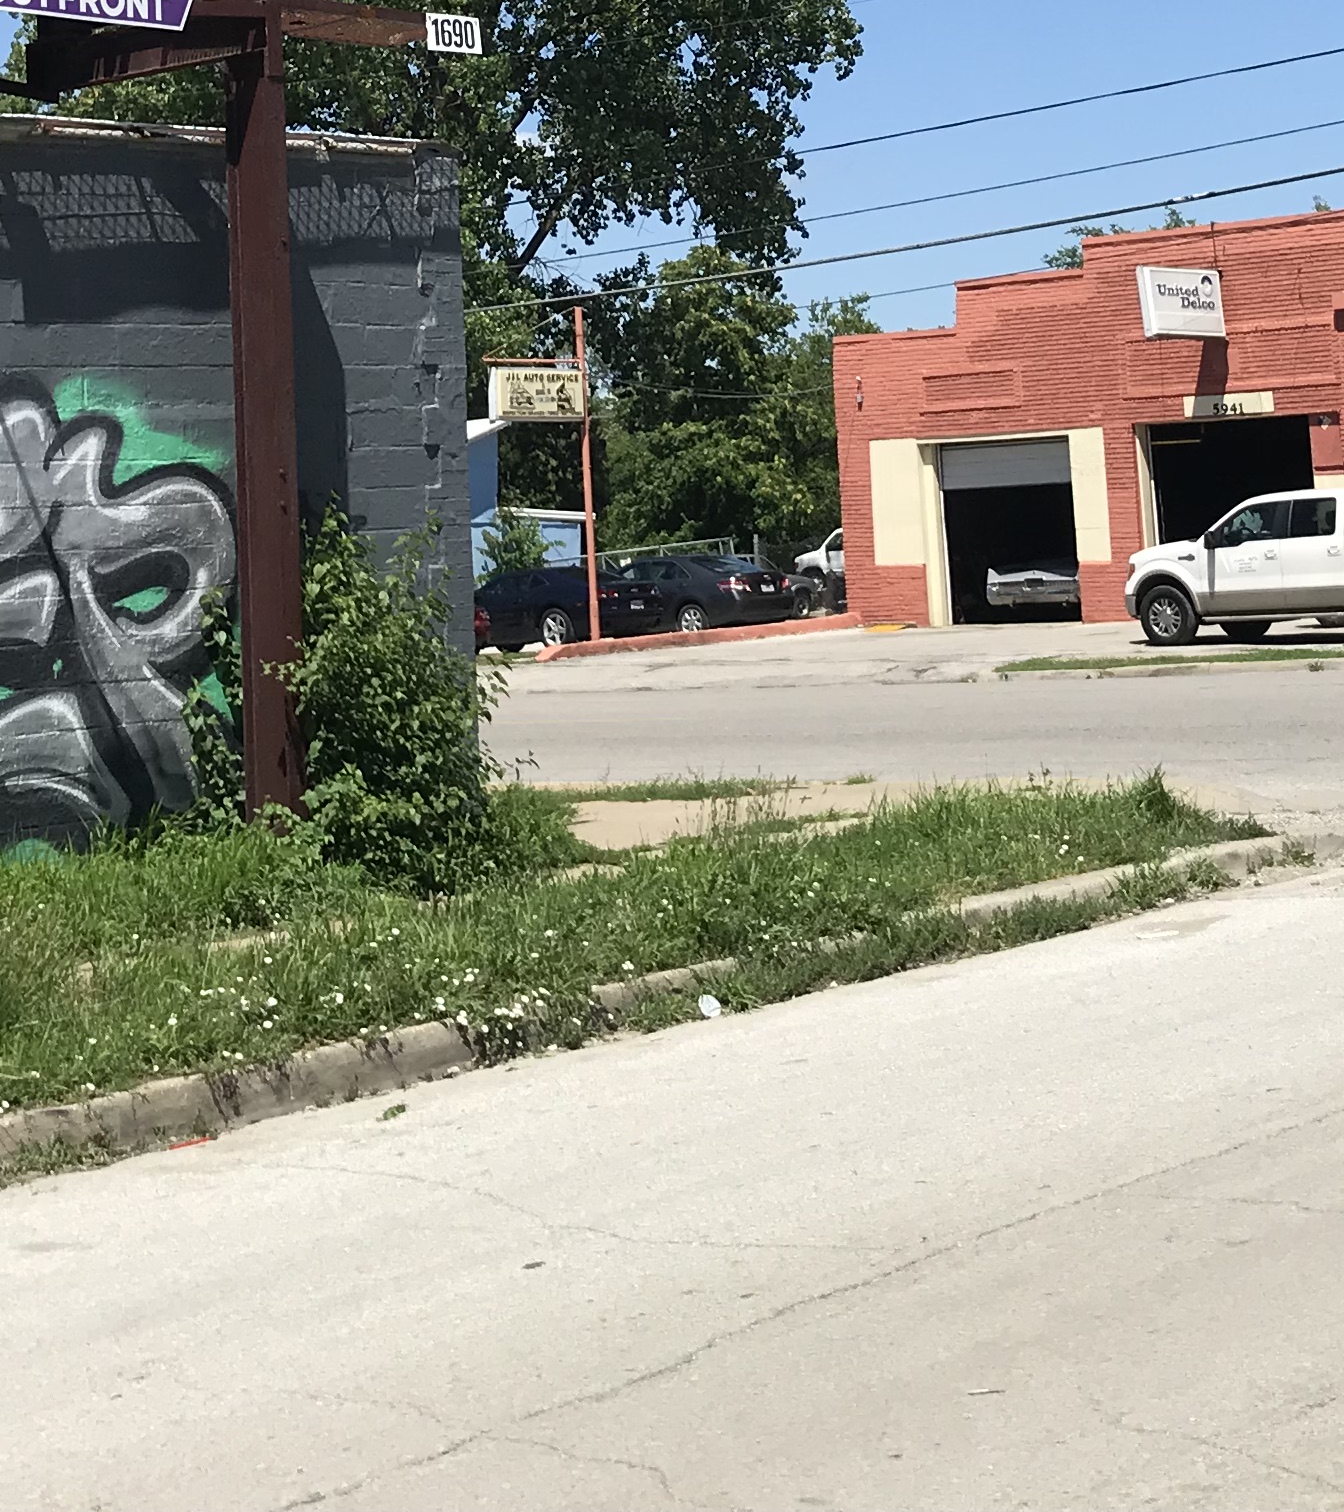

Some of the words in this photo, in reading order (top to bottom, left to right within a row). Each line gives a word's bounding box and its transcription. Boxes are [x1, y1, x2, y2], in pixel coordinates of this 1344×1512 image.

[431, 18, 475, 49] 1690
[1156, 283, 1199, 297] United
[1180, 296, 1216, 310] Delco
[523, 372, 544, 383] AUTO
[546, 373, 579, 384] SERVICE
[1212, 402, 1245, 416] 5941
